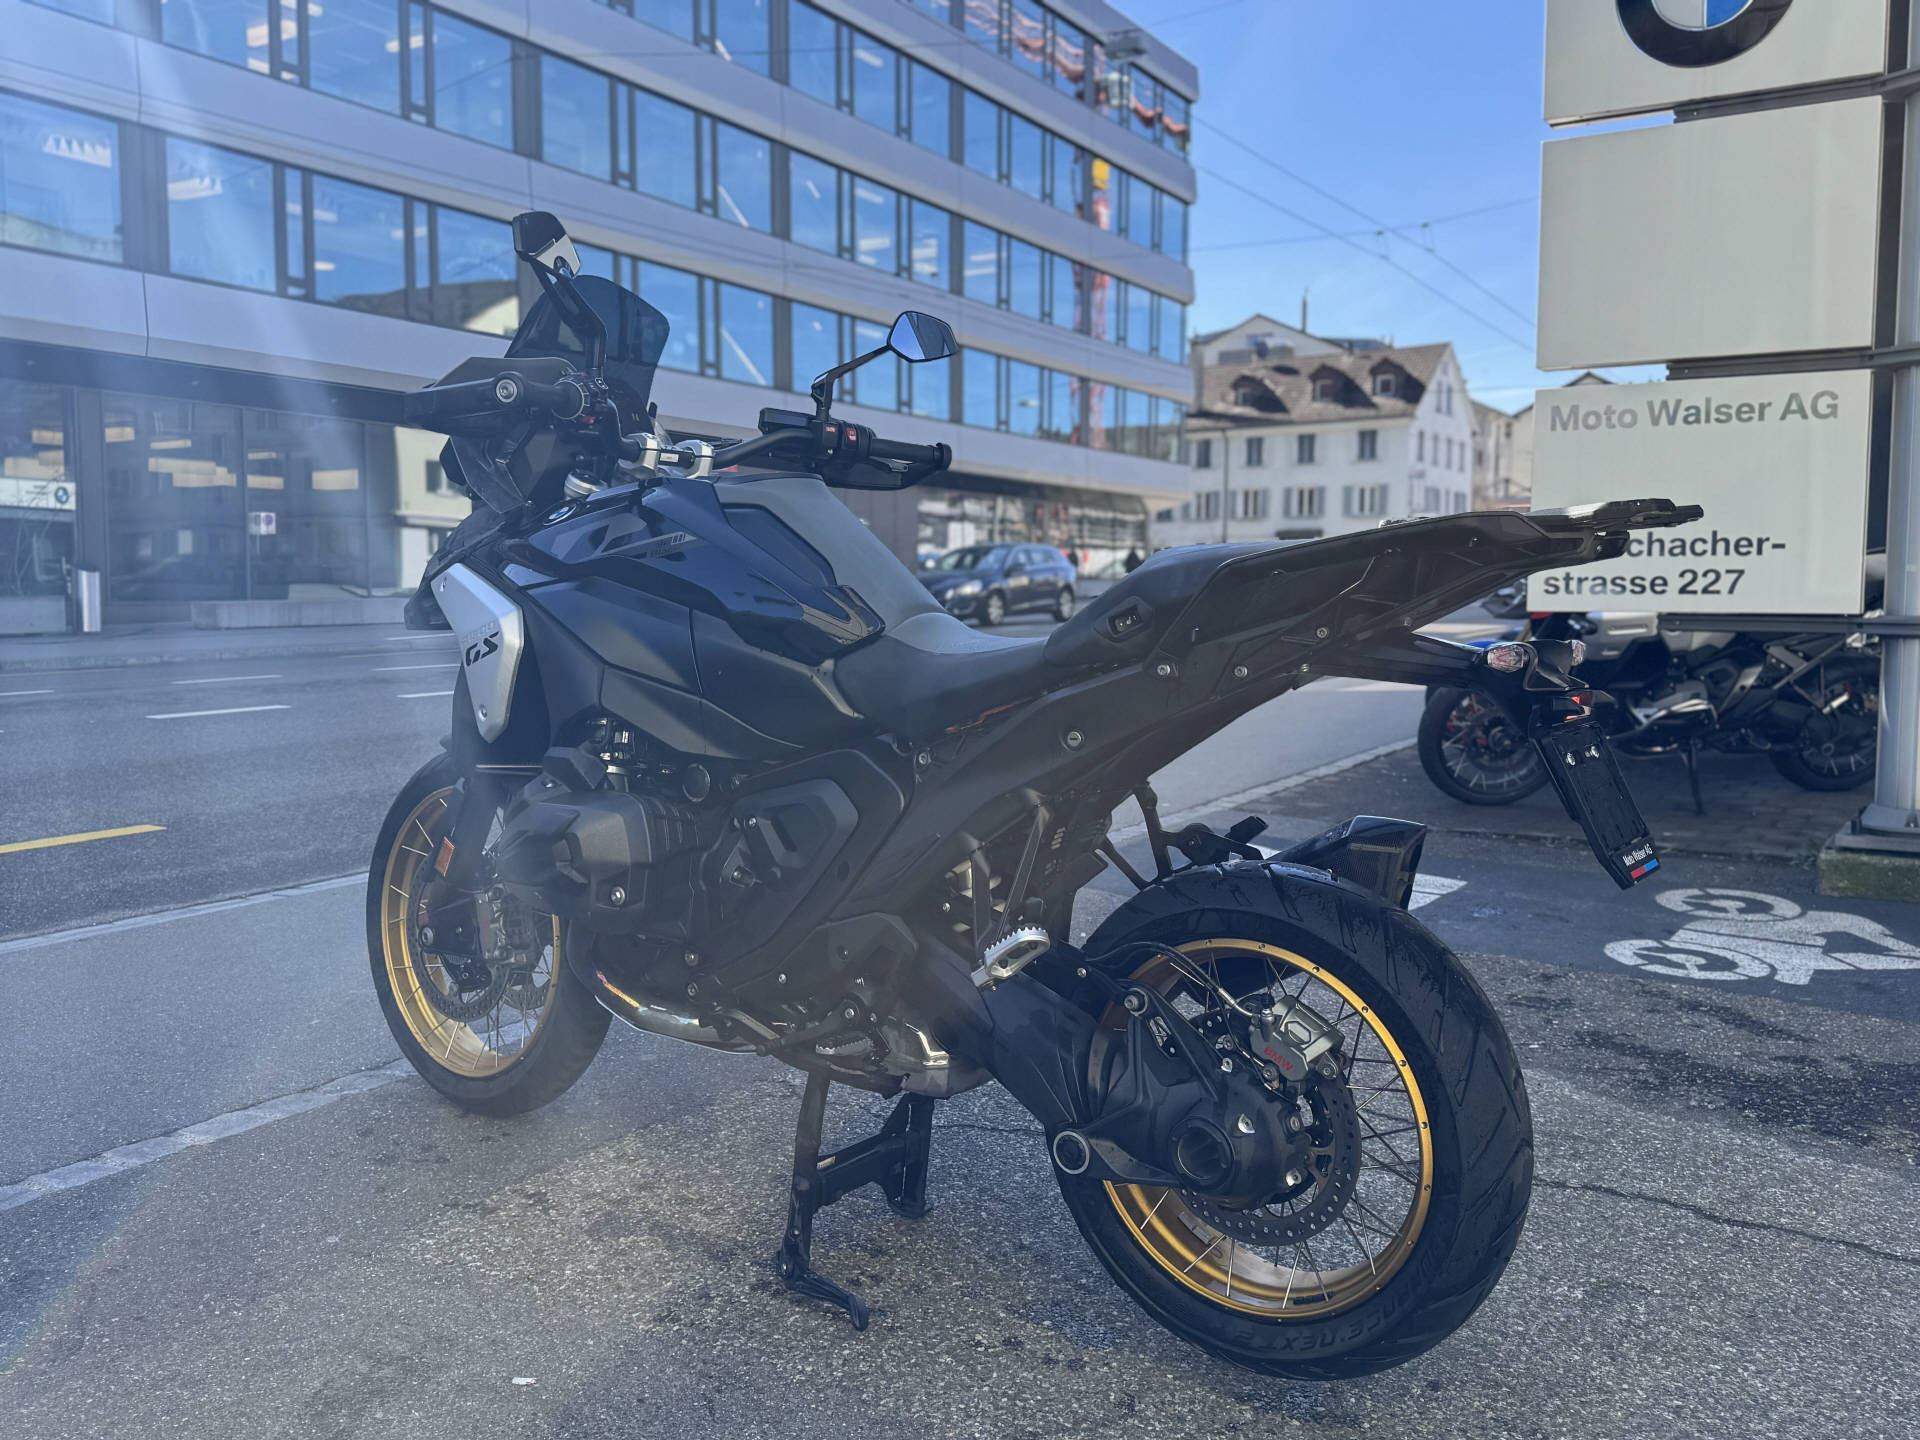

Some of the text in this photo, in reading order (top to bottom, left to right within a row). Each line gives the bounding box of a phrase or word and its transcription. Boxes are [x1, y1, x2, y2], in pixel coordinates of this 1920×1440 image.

[1549, 390, 1839, 432] Moto Walser AG
[1626, 530, 1786, 558] chacher-
[1543, 568, 1746, 595] strasse 227
[465, 631, 500, 667] GS
[1622, 854, 1635, 867] Moto
[1264, 1045, 1295, 1072] BMW
